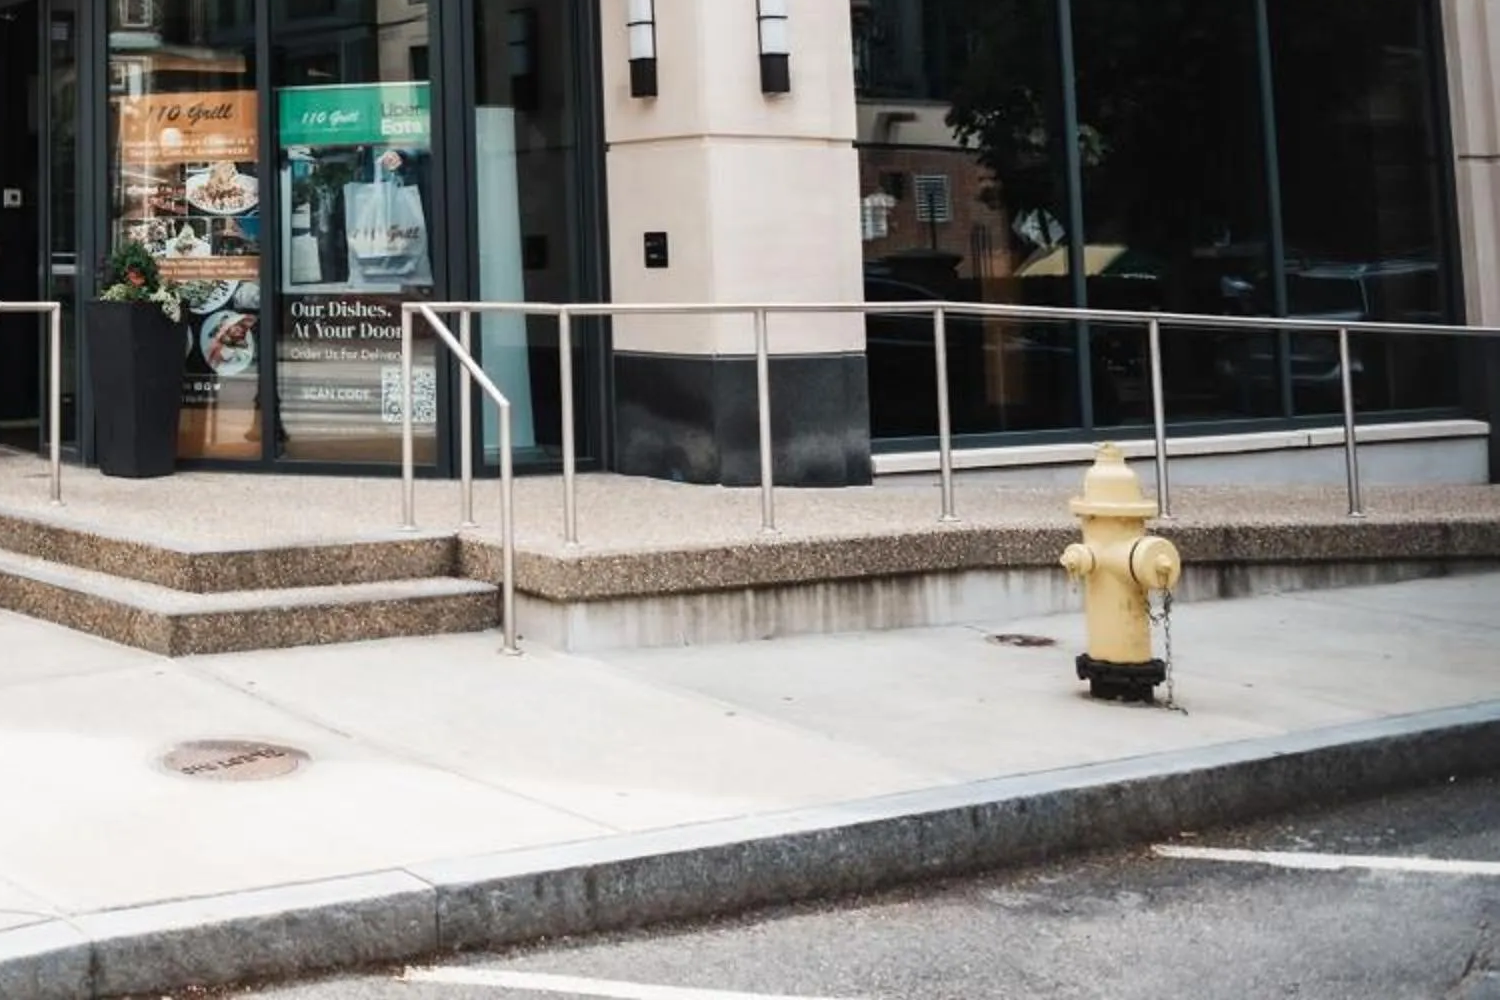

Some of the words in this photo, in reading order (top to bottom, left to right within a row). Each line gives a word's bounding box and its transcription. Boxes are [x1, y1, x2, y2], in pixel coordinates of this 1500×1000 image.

[187, 101, 234, 127] Grill
[328, 300, 392, 317] Dishes.
[292, 323, 309, 339] At
[314, 321, 356, 339] Your
